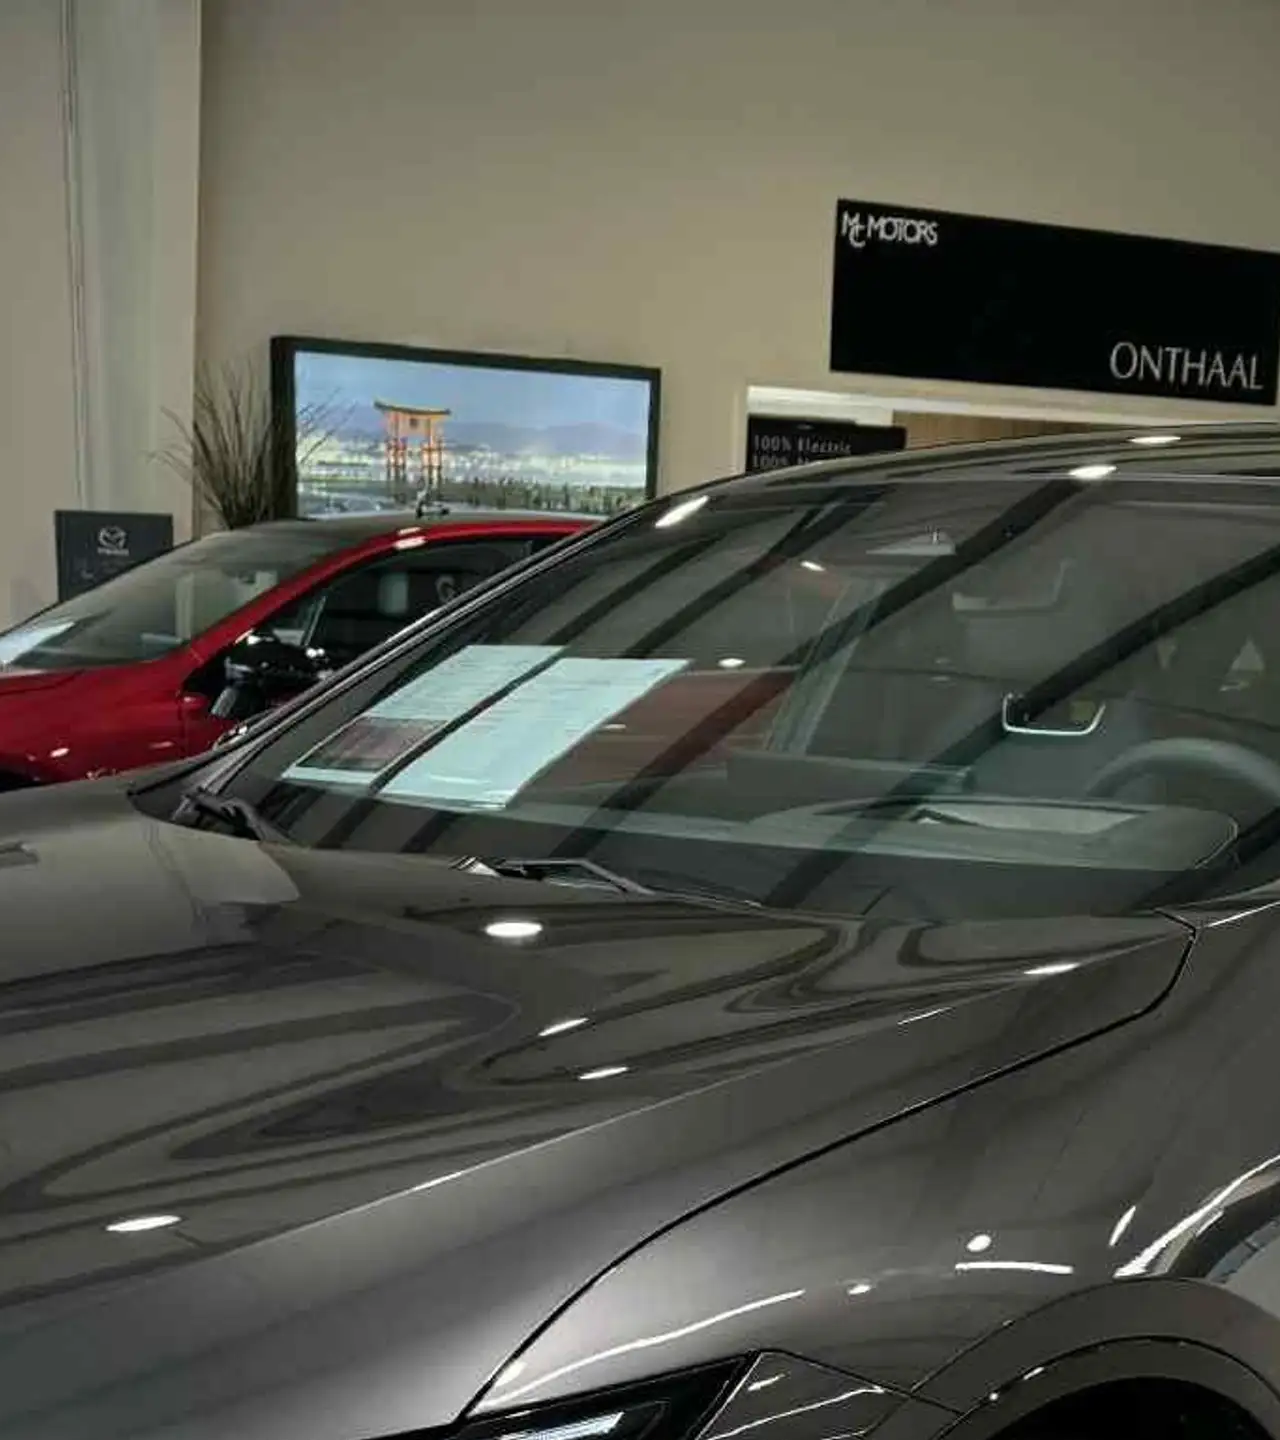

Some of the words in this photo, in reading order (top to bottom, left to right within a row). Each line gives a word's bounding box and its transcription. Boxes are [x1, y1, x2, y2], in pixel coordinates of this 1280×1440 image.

[867, 213, 939, 247] MOTORS
[1109, 341, 1265, 390] ONTHAAL
[797, 435, 852, 454] Electric
